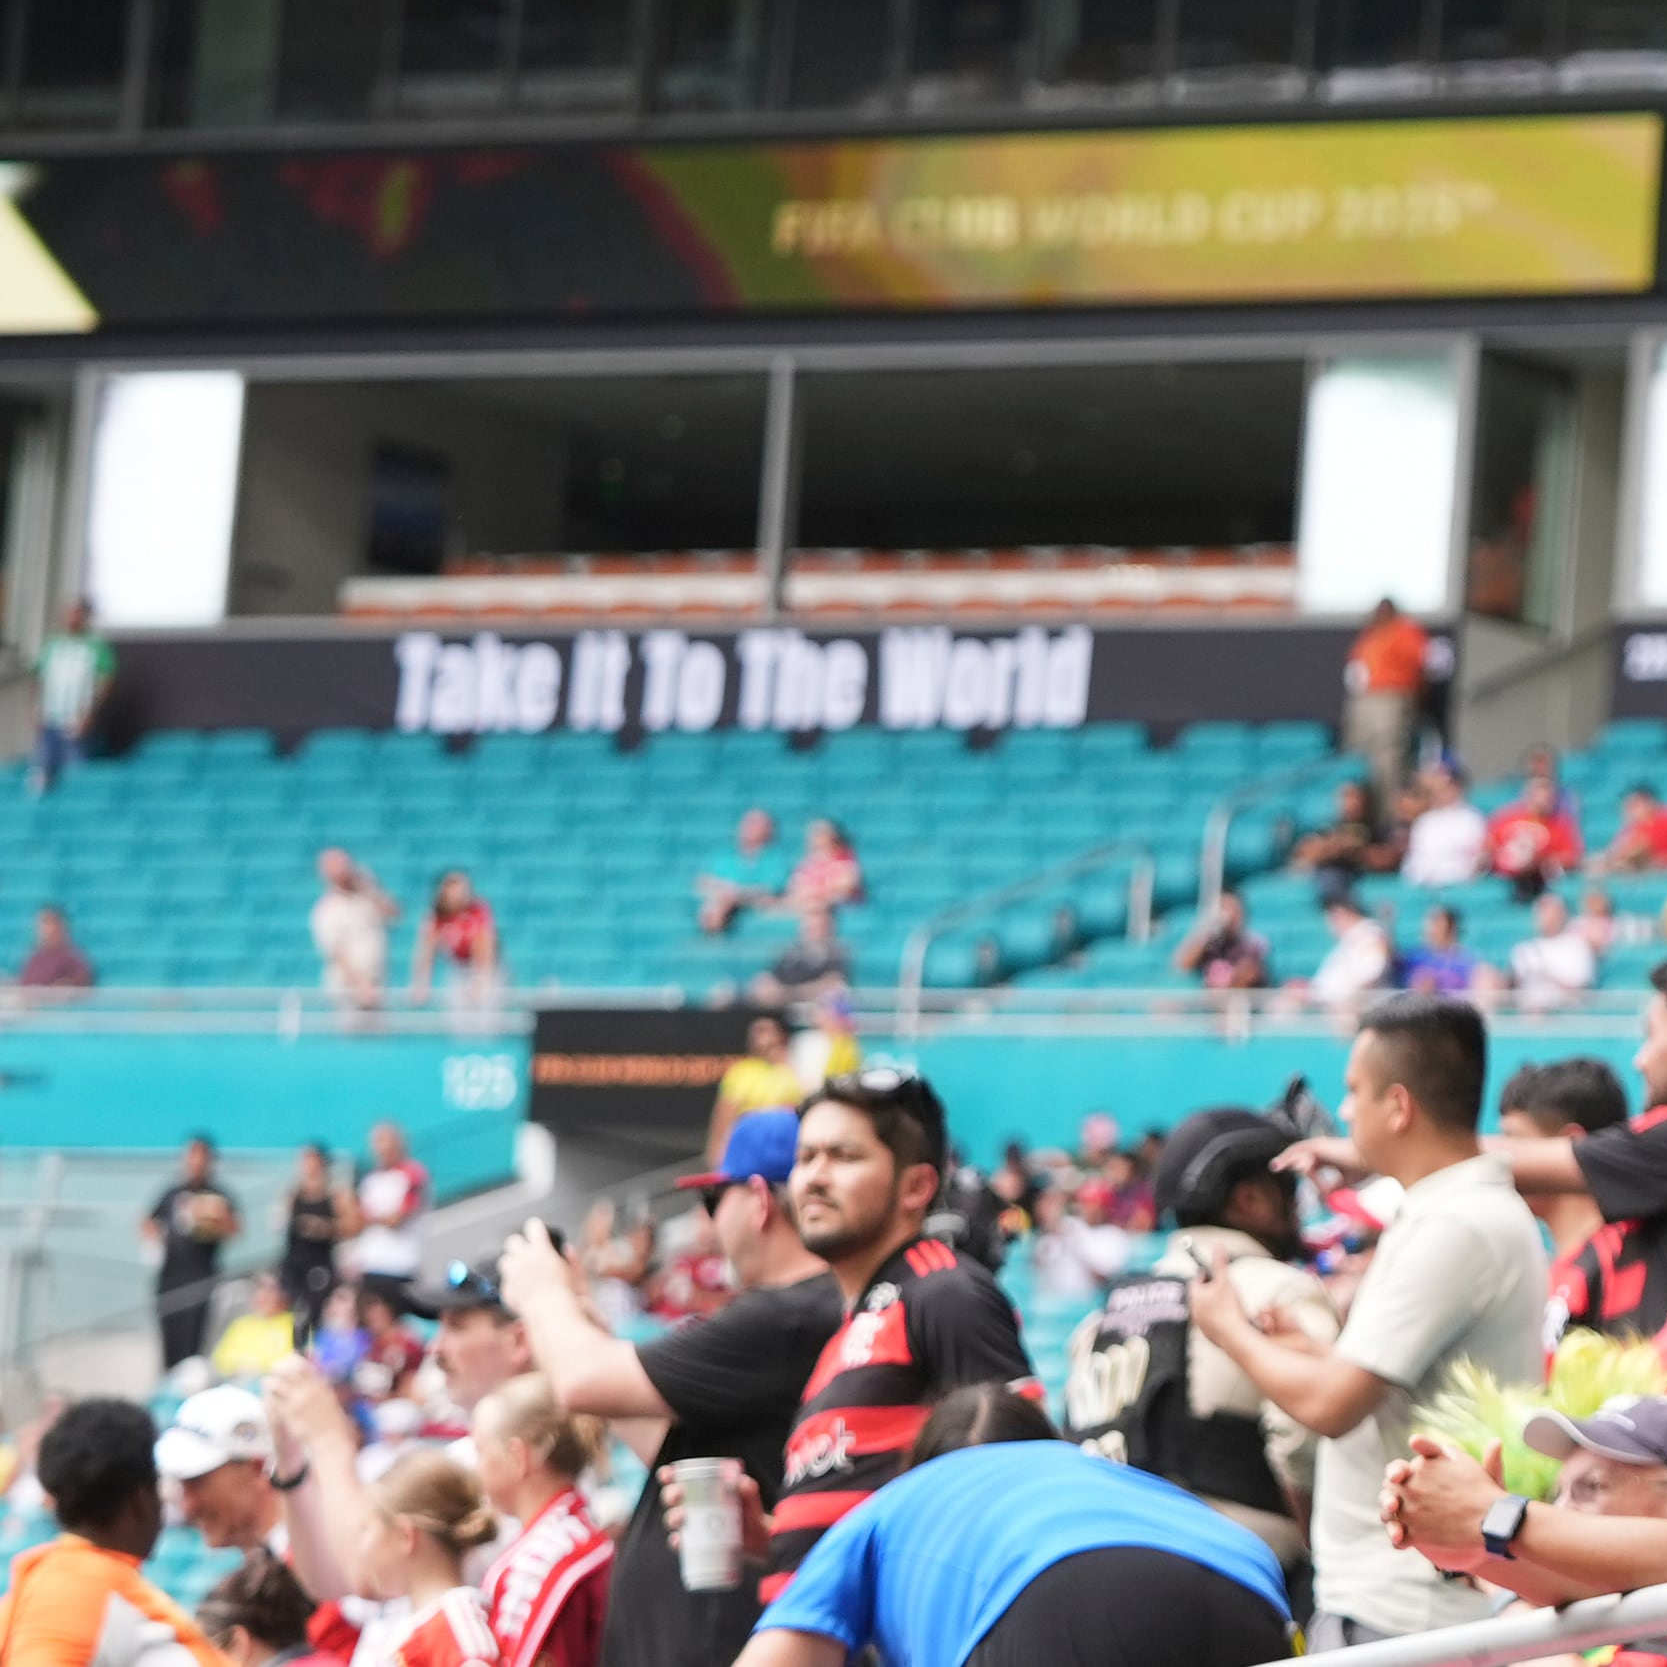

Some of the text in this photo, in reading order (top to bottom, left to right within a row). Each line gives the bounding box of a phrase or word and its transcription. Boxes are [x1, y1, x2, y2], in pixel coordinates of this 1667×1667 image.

[772, 199, 881, 256] FIFA
[1036, 190, 1211, 246] WORLD
[1222, 186, 1321, 244] CUP
[395, 624, 1093, 733] Take It To The World
